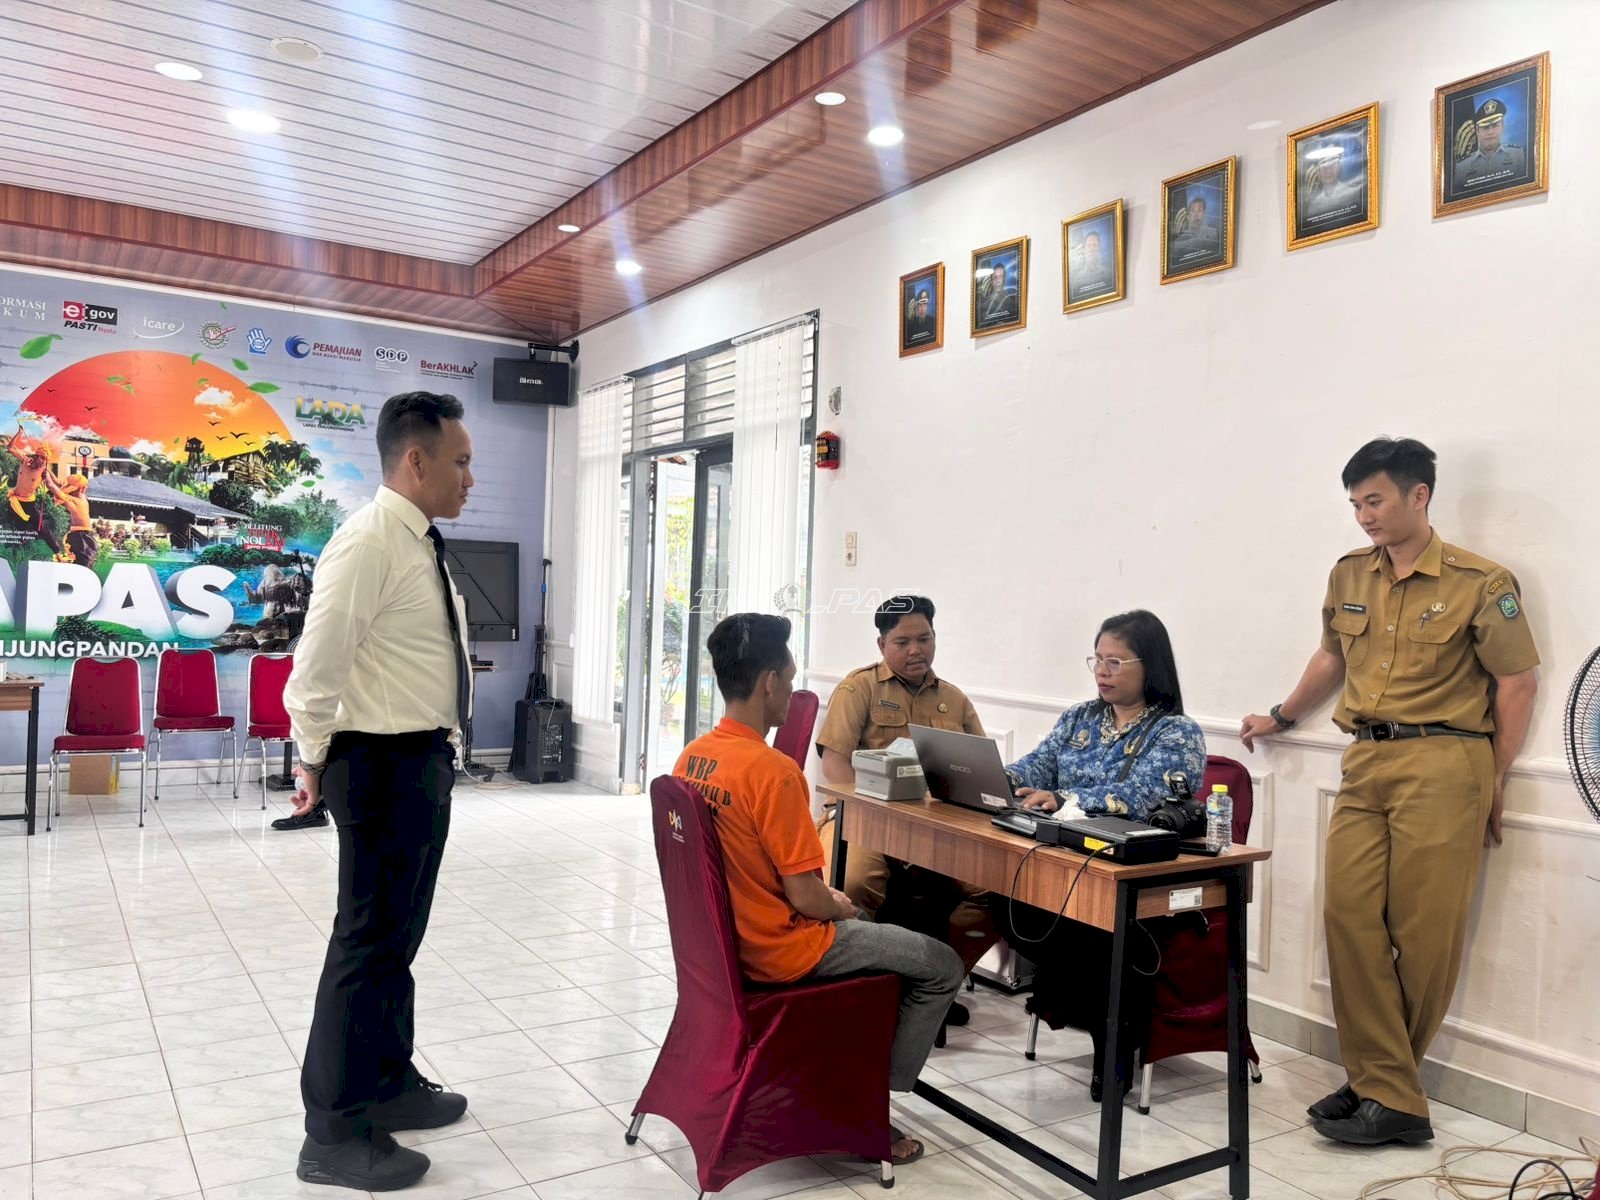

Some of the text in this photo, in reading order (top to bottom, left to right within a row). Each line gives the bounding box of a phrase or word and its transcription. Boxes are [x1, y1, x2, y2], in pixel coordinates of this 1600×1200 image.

[64, 320, 98, 332] PASTI
[313, 342, 363, 357] PEMAJUAN
[375, 346, 409, 363] SDP
[420, 360, 475, 375] BerAKHLAK
[295, 396, 367, 427] LADA
[0, 558, 237, 641] PAS
[0, 640, 179, 659] JUNGPANDA
[686, 755, 718, 781] WBP
